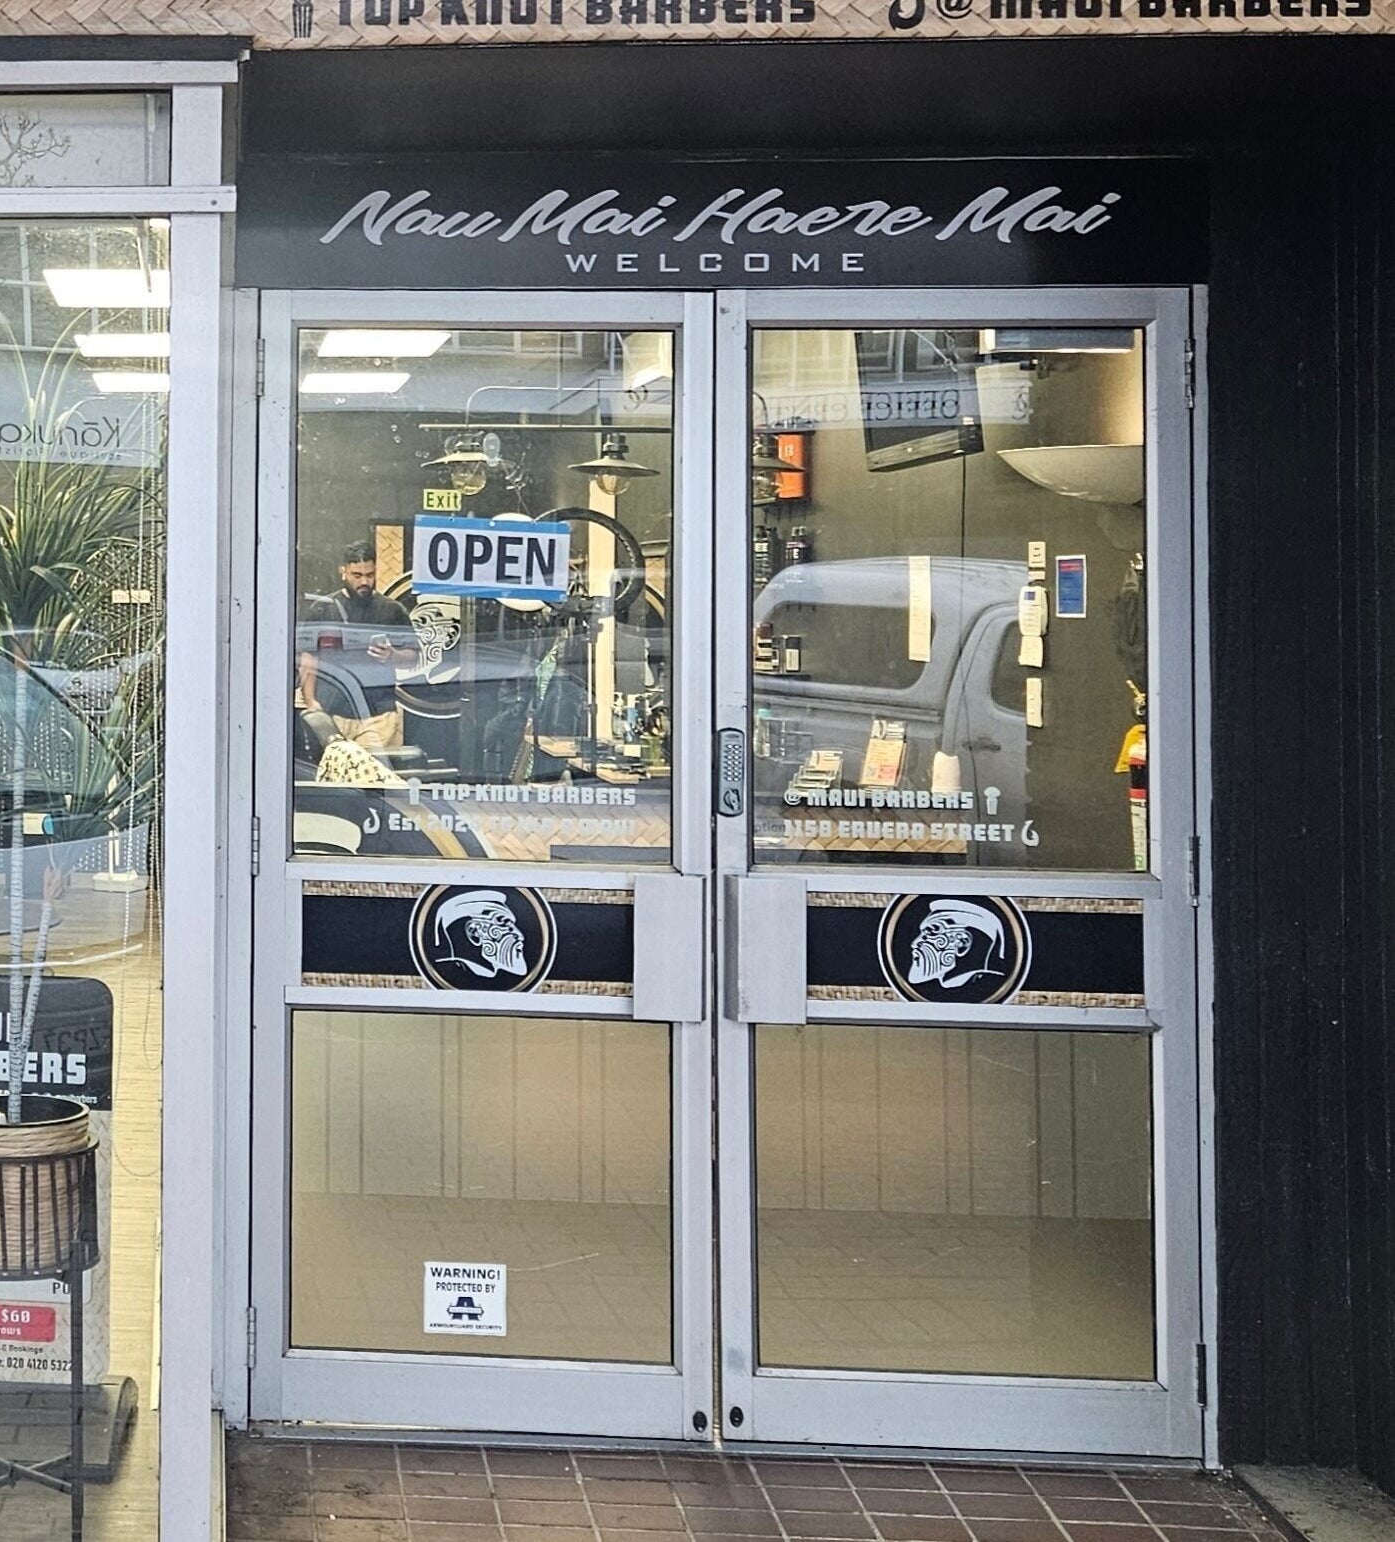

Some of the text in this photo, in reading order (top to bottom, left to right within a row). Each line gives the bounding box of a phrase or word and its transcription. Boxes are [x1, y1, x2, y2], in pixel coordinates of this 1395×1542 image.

[586, 0, 816, 24] BARBERS
[319, 186, 1122, 246] Nau Mai Haere Mai
[565, 252, 865, 274] WELCOME
[426, 491, 459, 509] Exit
[428, 531, 556, 587] OPEN
[430, 782, 637, 805] TOP KNOT BARBERS
[784, 788, 974, 809] @ MAUI BARBERS
[838, 820, 925, 840] ERUERA
[931, 823, 1016, 842] STREET
[430, 1266, 501, 1280] WARNING!
[435, 1281, 496, 1293] PROTECTED BY
[0, 1308, 31, 1323] $60
[6, 1356, 25, 1369] 020
[26, 1358, 48, 1371] 4120
